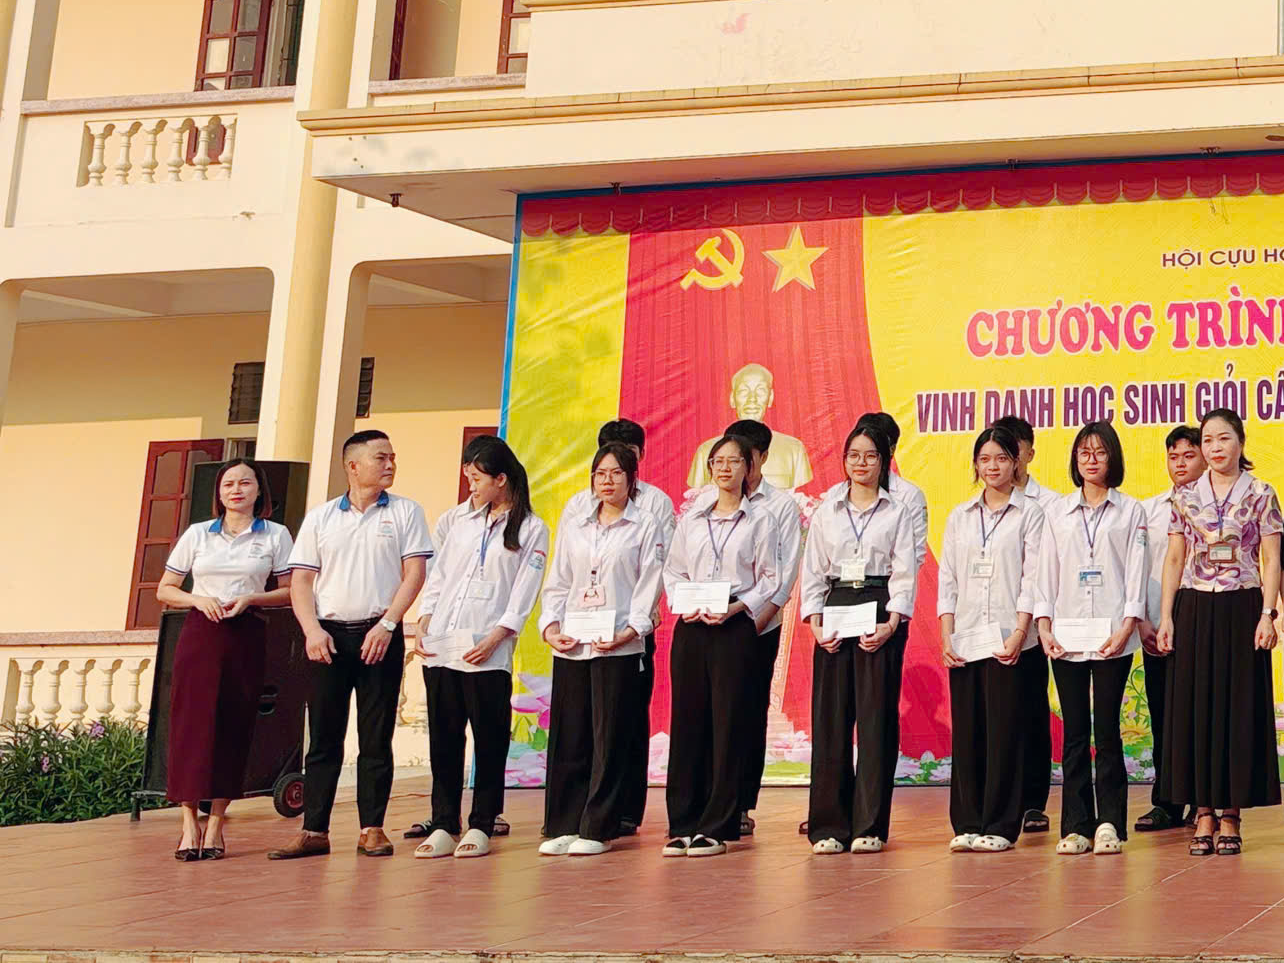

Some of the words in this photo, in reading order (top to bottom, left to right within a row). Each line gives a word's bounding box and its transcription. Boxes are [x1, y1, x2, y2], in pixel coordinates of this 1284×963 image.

[1162, 249, 1201, 269] HỘI
[1209, 249, 1255, 268] CỰU
[967, 299, 1155, 357] CHƯƠNG
[917, 391, 976, 433] VINH
[985, 388, 1055, 430] DANH
[1124, 383, 1186, 425] SINH
[1195, 362, 1247, 423] GIỎI
